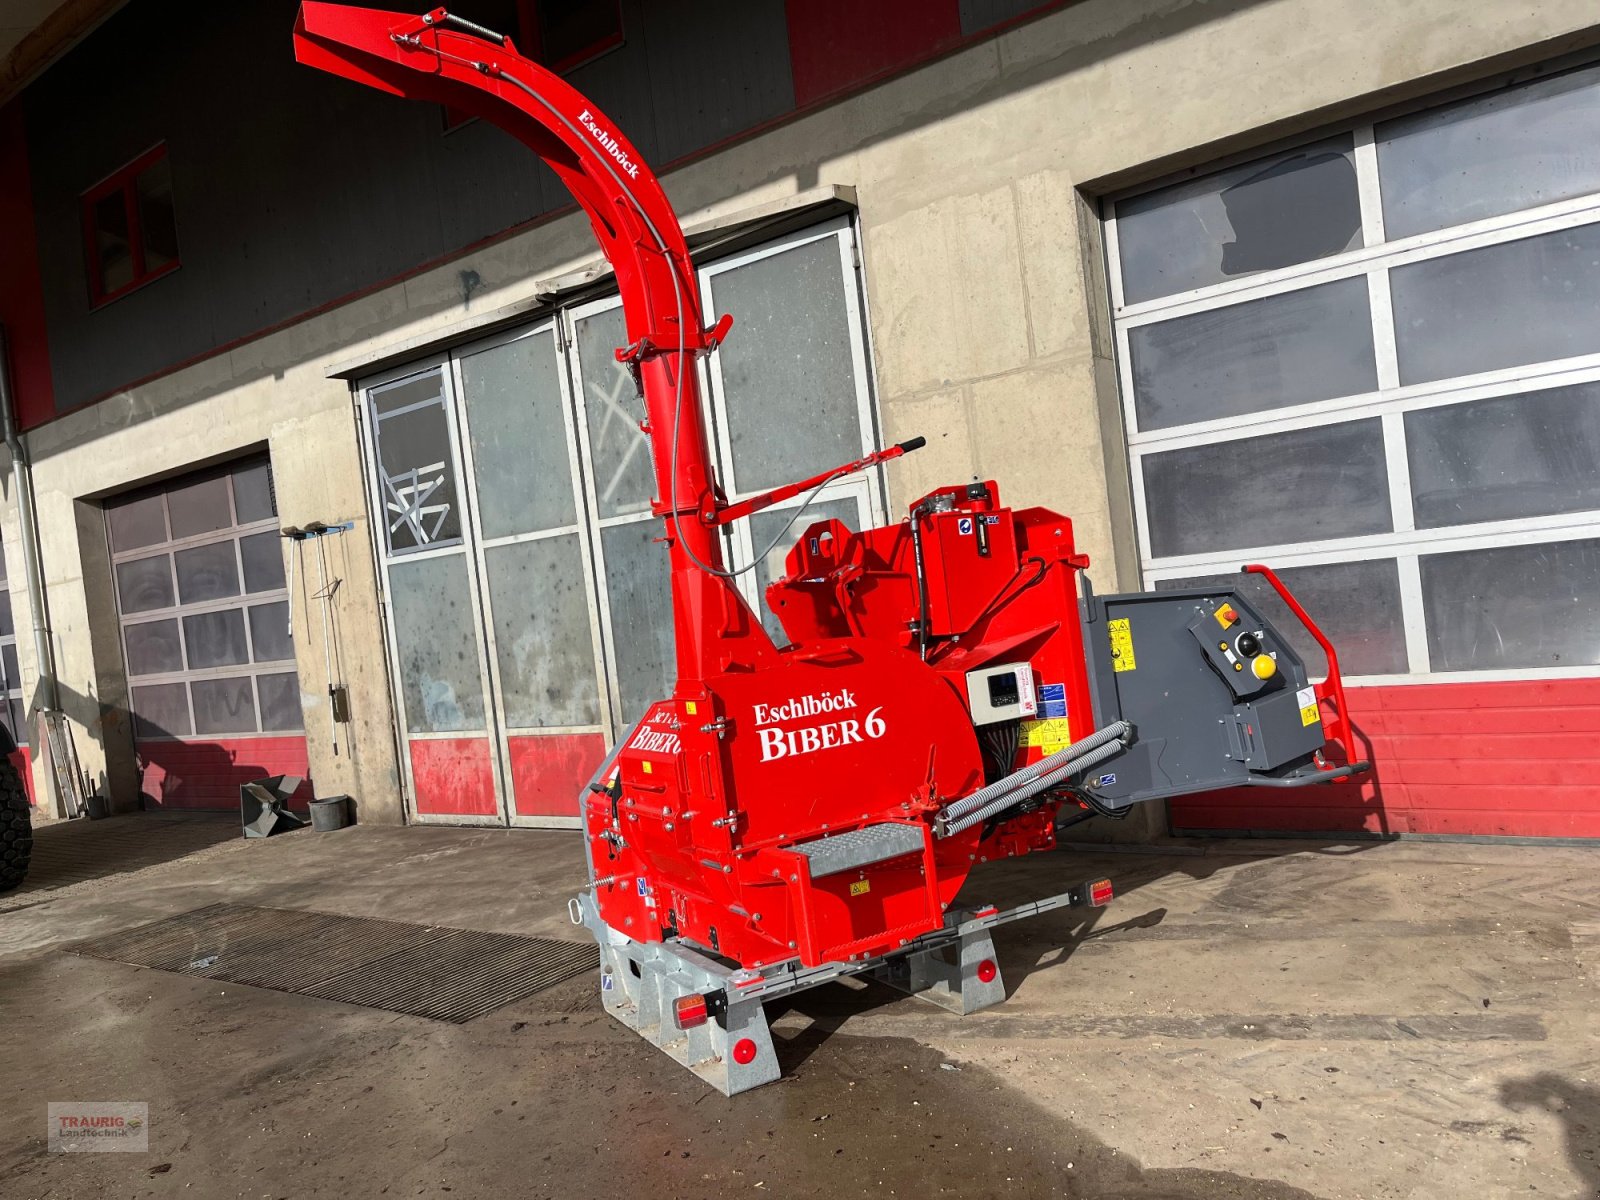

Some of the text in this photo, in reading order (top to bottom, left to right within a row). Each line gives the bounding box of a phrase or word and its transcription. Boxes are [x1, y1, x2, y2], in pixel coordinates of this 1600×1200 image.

[577, 108, 640, 180] Eschlböck
[752, 688, 858, 726] Eschlböck
[628, 725, 679, 753] BIBER
[755, 706, 886, 763] BIBER 6
